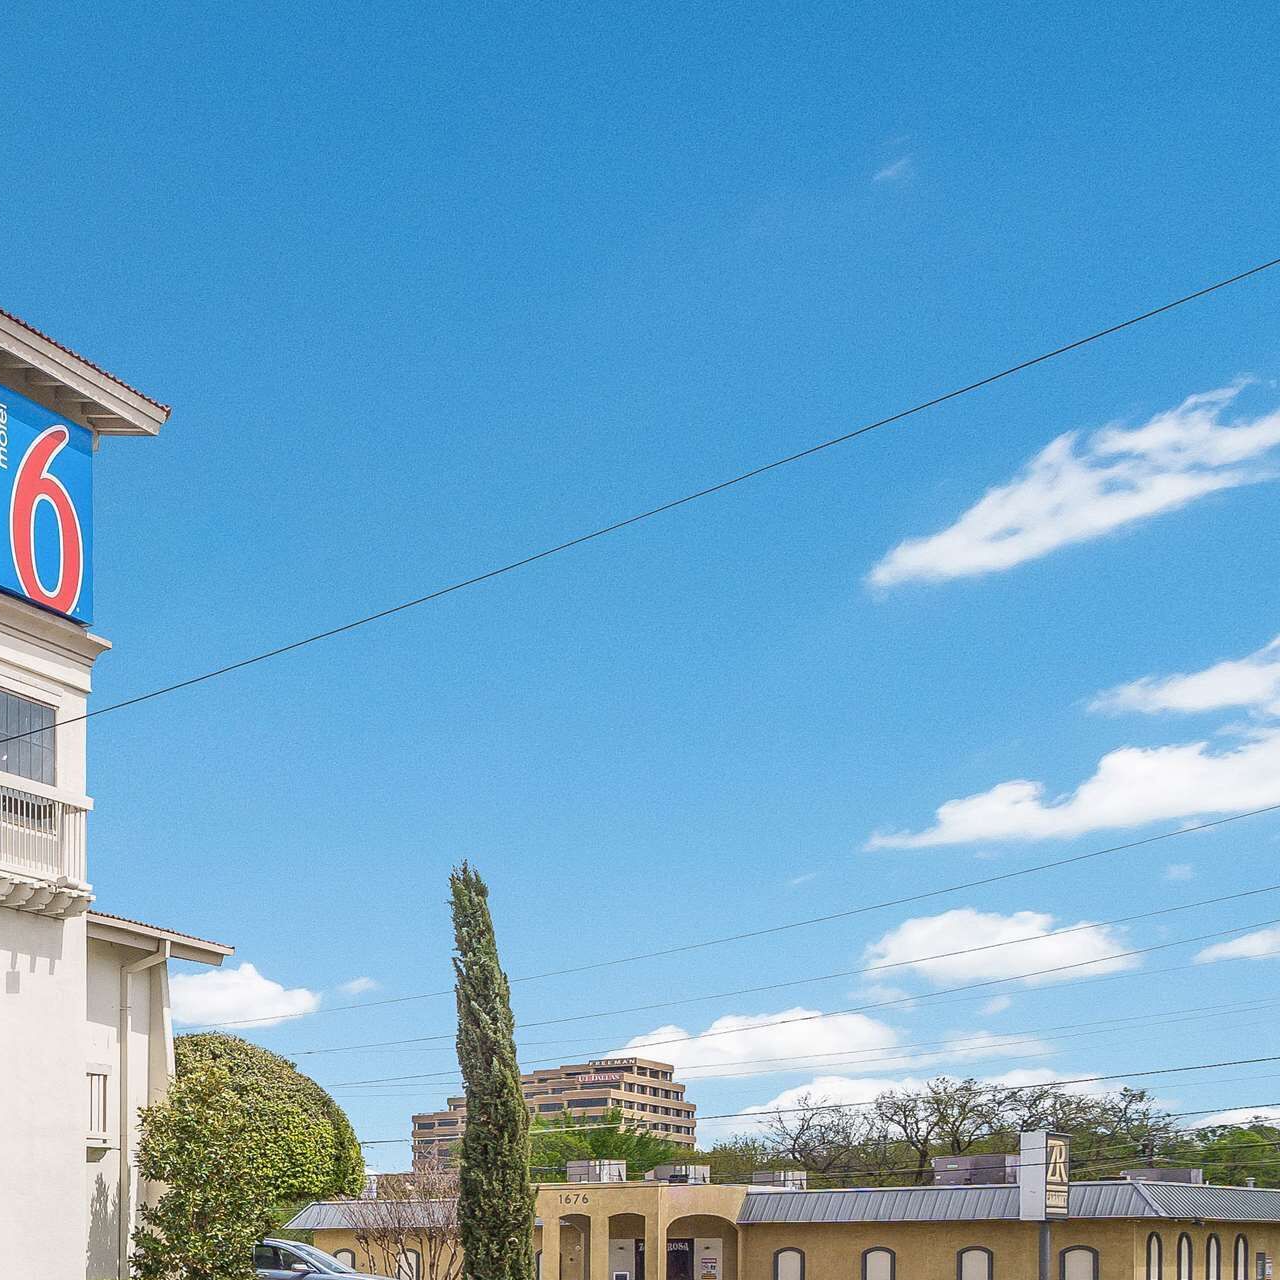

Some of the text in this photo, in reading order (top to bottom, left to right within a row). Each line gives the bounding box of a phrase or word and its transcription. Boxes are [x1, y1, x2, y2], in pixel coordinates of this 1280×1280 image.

[9, 424, 84, 616] 6
[591, 1073, 620, 1081] DALLAS
[559, 1193, 589, 1204] 1676
